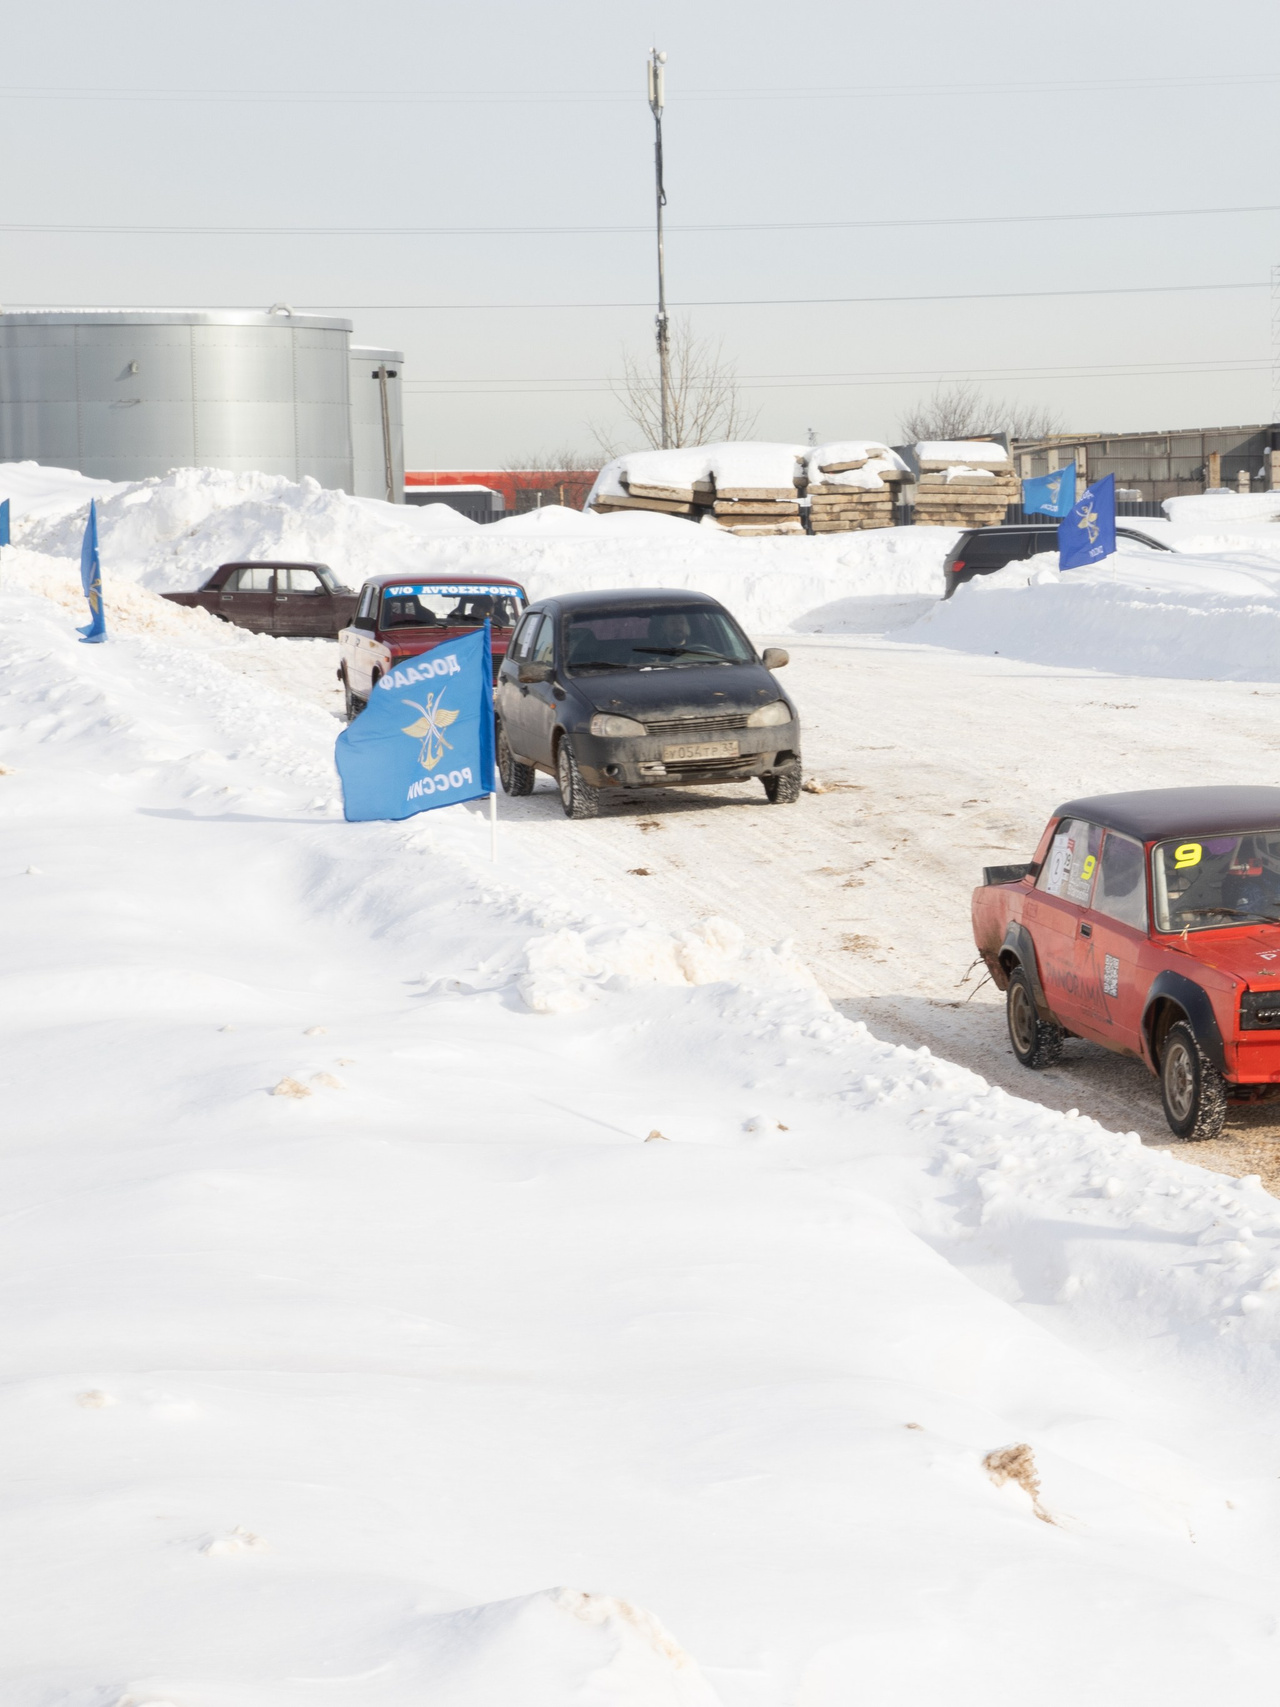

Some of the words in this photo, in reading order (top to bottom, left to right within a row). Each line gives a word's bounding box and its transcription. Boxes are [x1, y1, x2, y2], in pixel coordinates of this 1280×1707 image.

[389, 586, 414, 596] V/O
[421, 586, 518, 596] AVTOEXPORT
[1080, 854, 1097, 880] 9
[1174, 843, 1202, 869] 9
